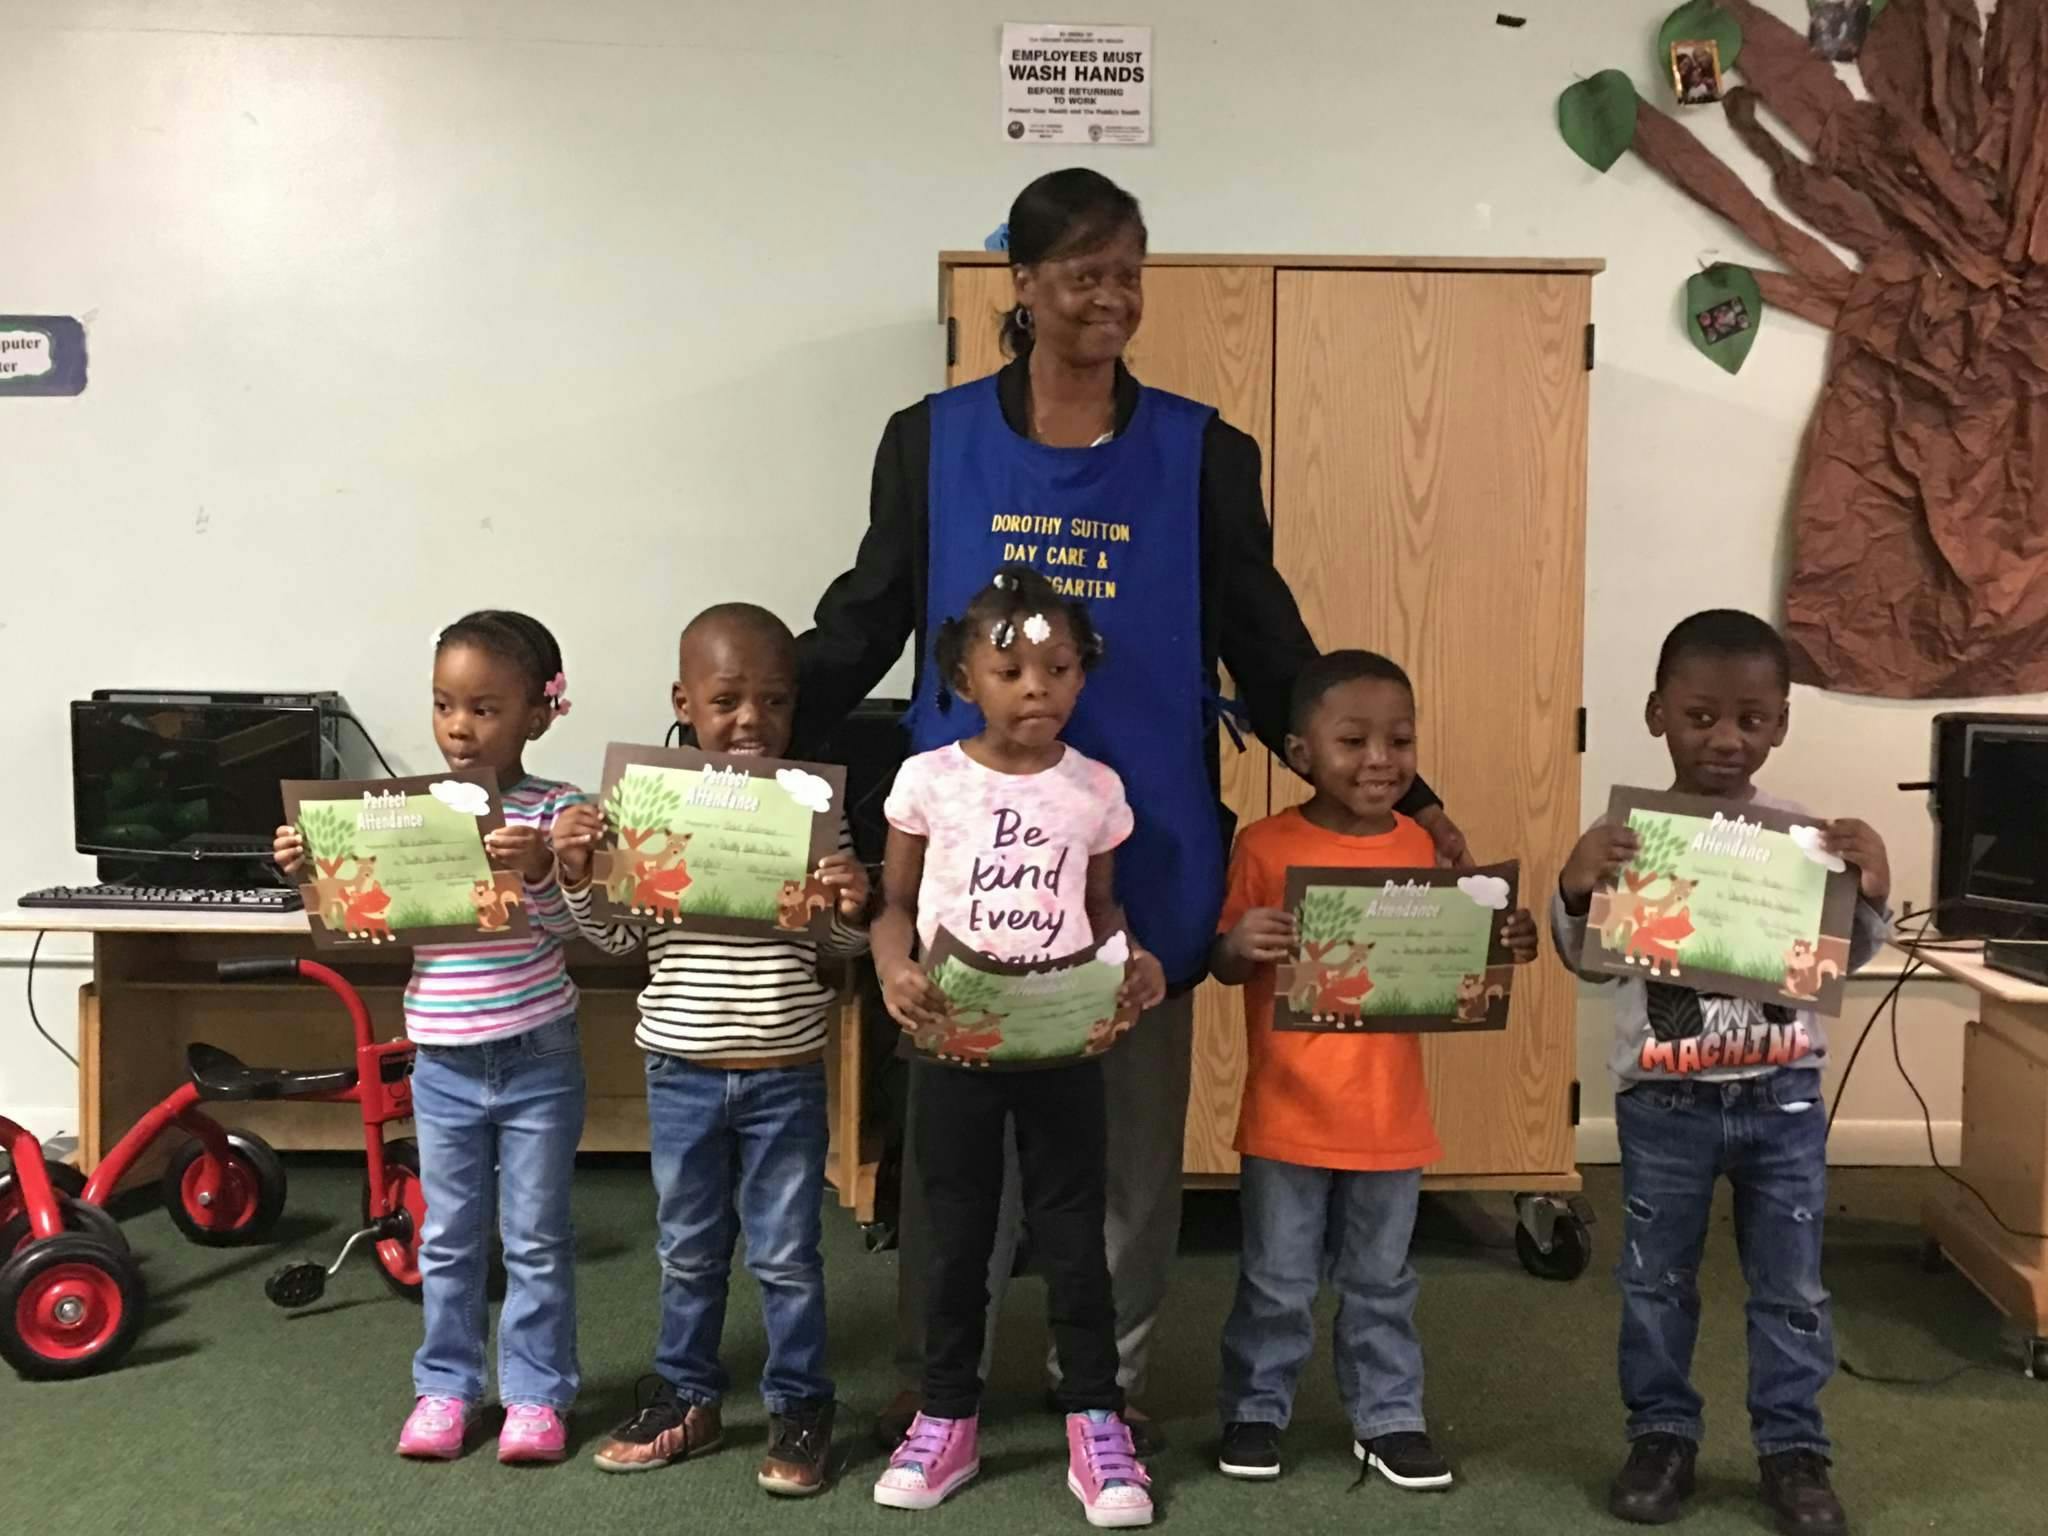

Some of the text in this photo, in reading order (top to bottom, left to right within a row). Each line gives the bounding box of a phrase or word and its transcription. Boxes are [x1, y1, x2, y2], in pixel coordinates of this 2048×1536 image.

[1012, 49, 1142, 63] EMPLOYEES MUST
[1009, 65, 1145, 83] WASH HANDS
[1027, 87, 1124, 96] BEFORE RETURNING
[1069, 97, 1096, 105] WORK
[0, 338, 41, 353] puter
[991, 514, 1130, 542] DOROTHY SUTTON
[1004, 543, 1108, 569] DAY CARE &
[1044, 576, 1116, 598] GARTEN
[703, 763, 750, 787] Perfect
[363, 789, 406, 809] Perfect
[356, 810, 423, 831] Attendance
[992, 808, 1050, 849] Be
[1712, 811, 1762, 839] Perfect
[1692, 832, 1770, 862] Attendance
[968, 846, 1069, 896] kind
[1383, 878, 1431, 897] Perfect
[969, 899, 1065, 948] Every
